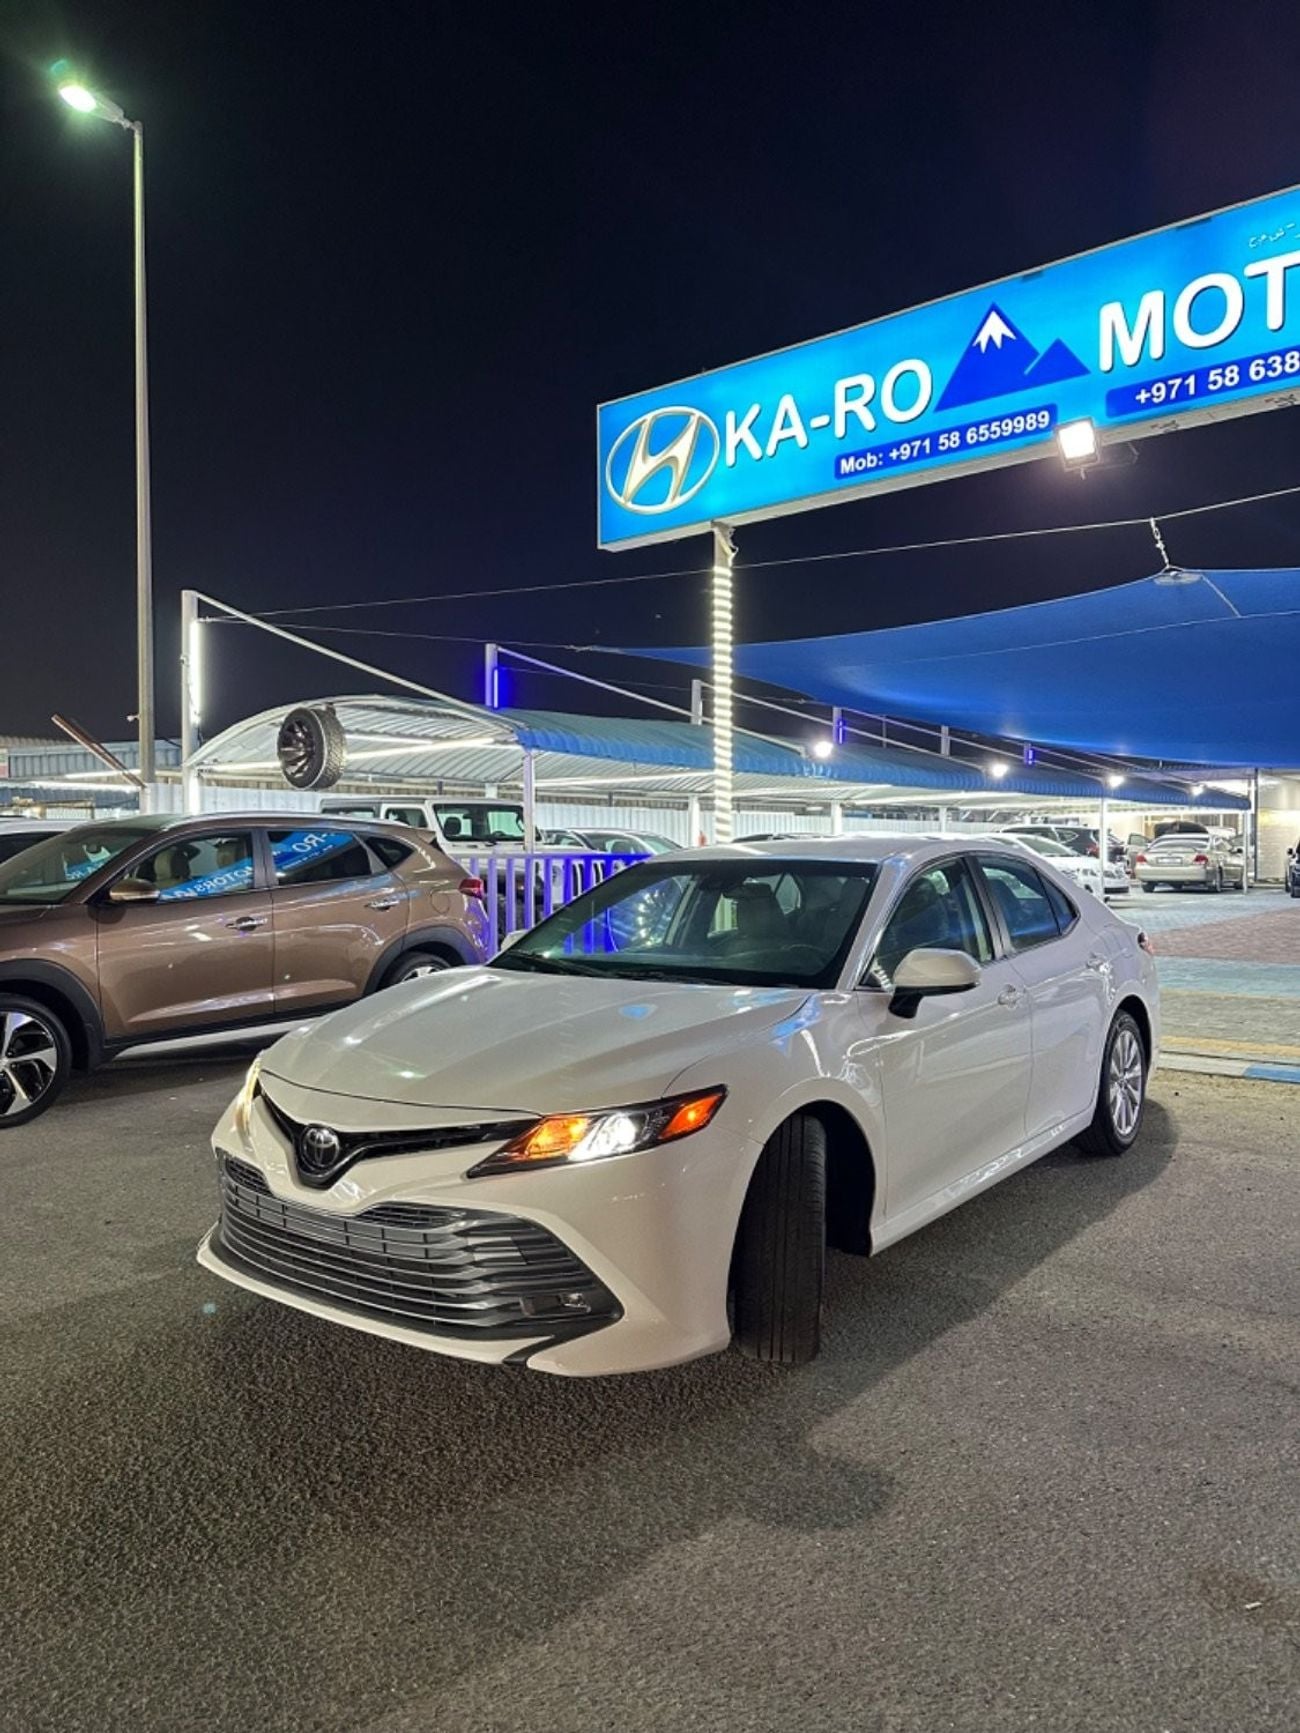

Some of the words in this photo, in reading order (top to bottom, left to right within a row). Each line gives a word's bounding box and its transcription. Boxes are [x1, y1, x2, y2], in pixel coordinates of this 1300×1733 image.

[725, 358, 933, 468] KA-RO
[1099, 250, 1300, 373] MOT
[1135, 374, 1196, 404] +971
[1207, 365, 1240, 391] 58
[1249, 350, 1300, 381] 638
[840, 453, 884, 475] Mob:
[889, 438, 931, 461] +971
[938, 431, 961, 450] 58
[966, 410, 1050, 444] 6559989
